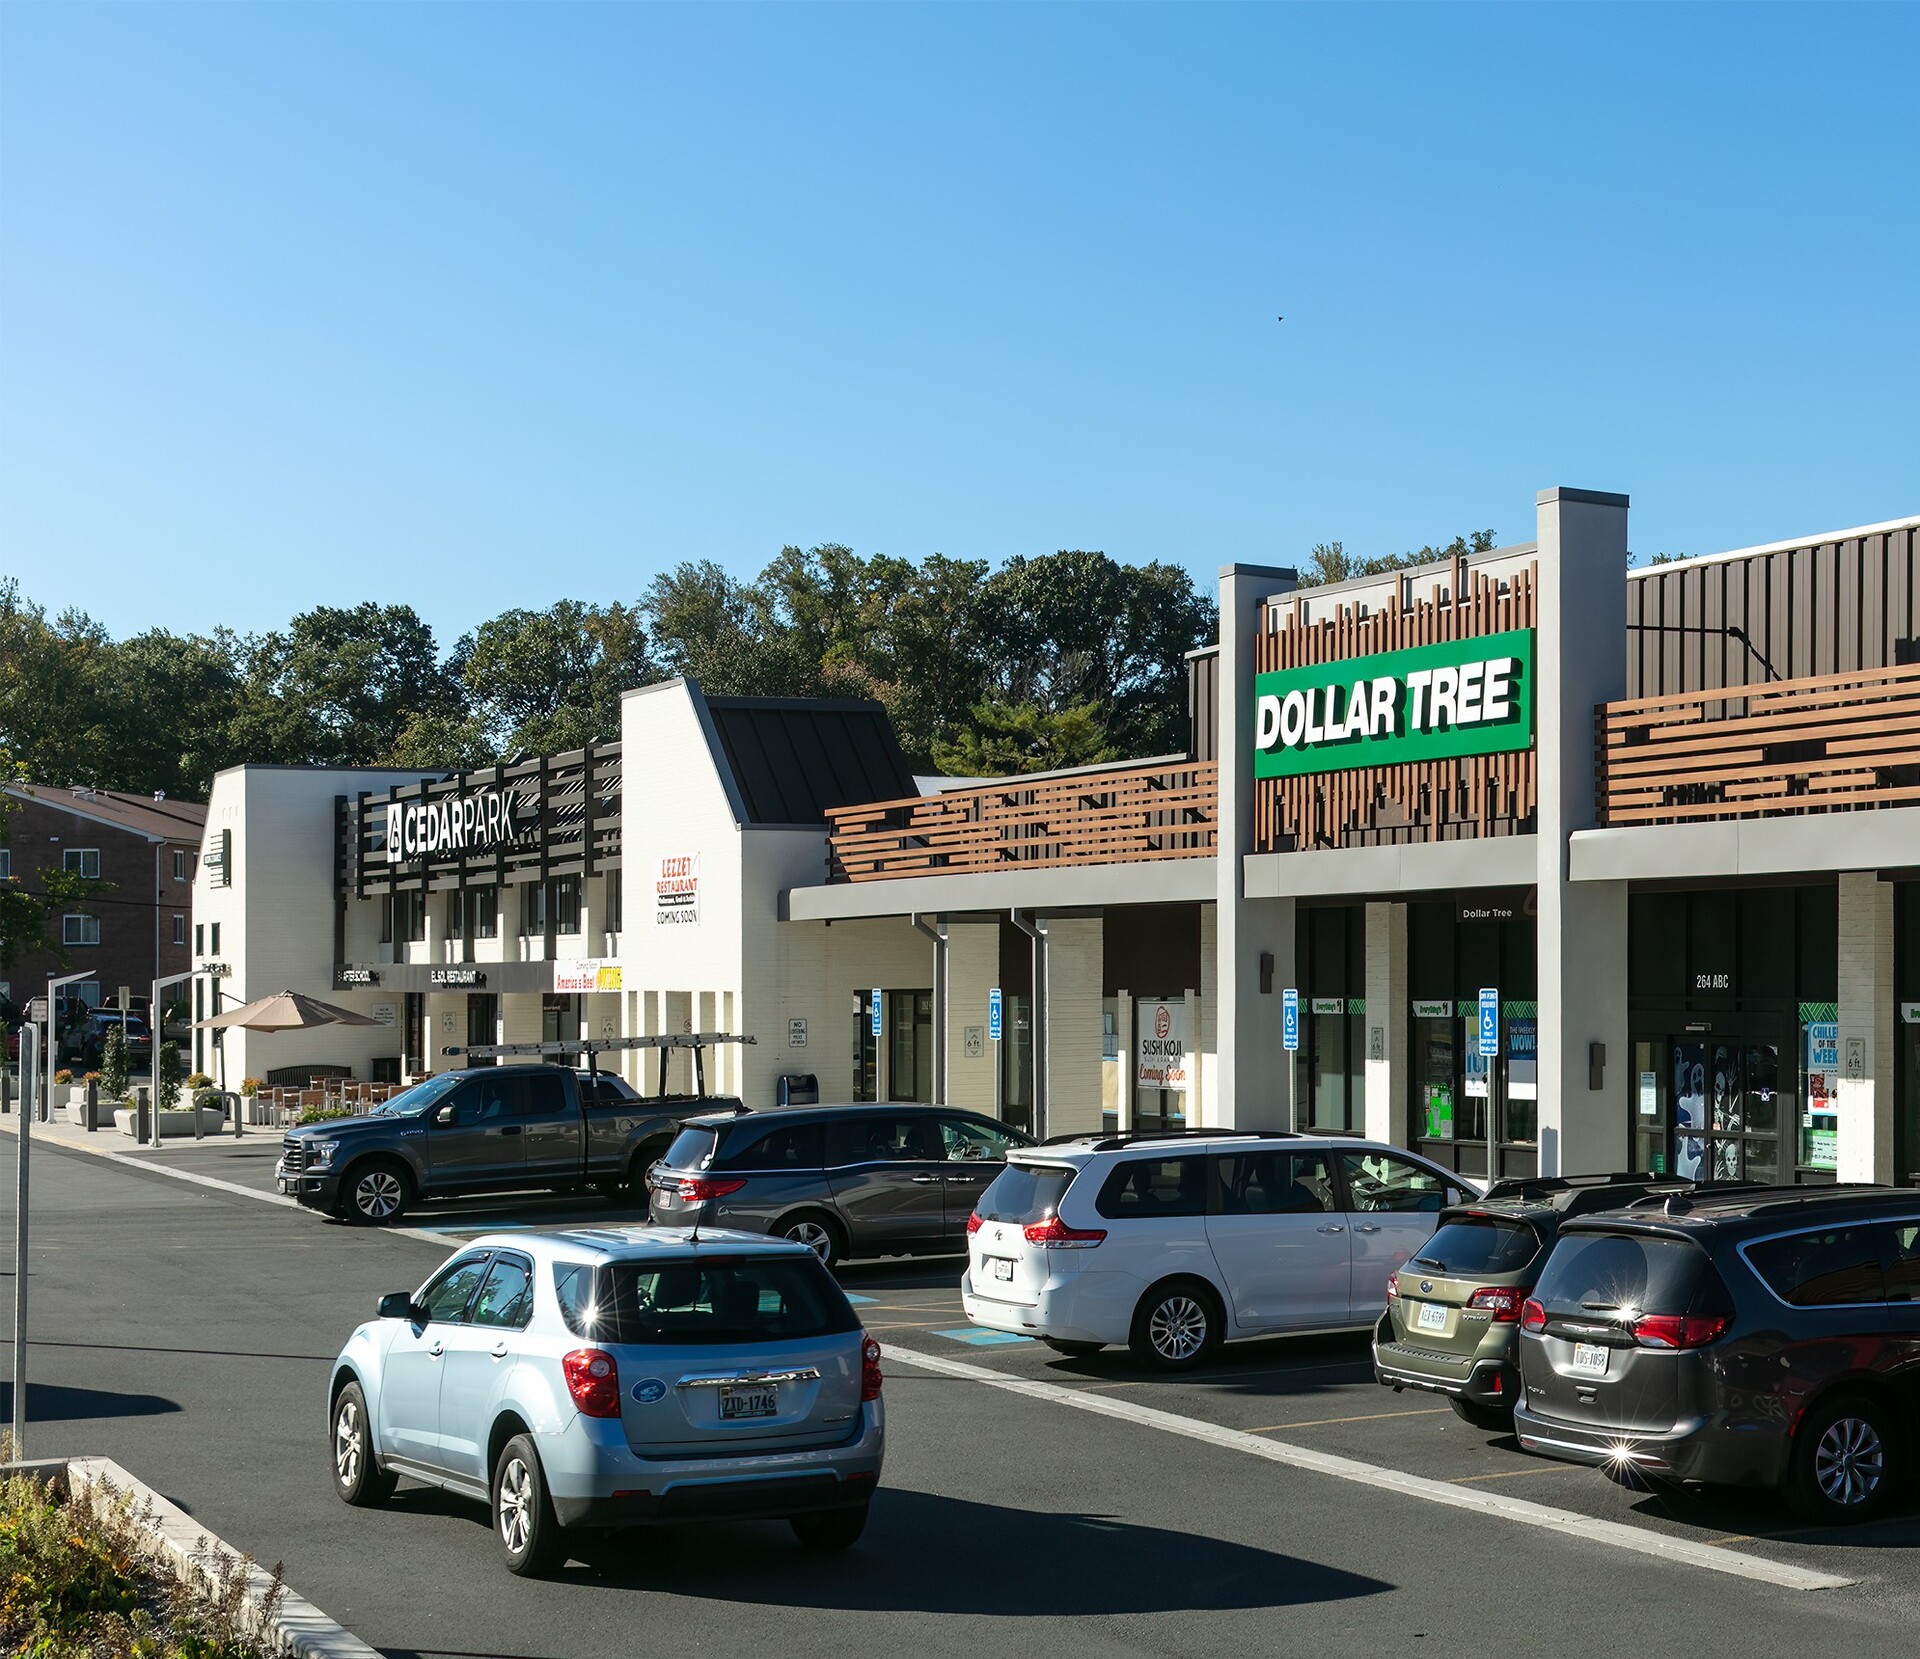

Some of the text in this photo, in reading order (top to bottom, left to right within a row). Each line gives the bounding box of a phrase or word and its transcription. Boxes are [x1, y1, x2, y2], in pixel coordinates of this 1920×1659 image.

[1256, 657, 1512, 750] DOLLAR TREE
[662, 857, 691, 878] LEZZET
[656, 878, 698, 894] RESTAURANT
[657, 909, 697, 925] COMING SOON
[1463, 908, 1512, 918] Dollar Tree
[1696, 974, 1728, 988] 264 ABC
[1142, 1039, 1182, 1056] SUSHI KOJI
[1510, 1034, 1536, 1051] WOW!
[1818, 1040, 1836, 1049] OF THE
[1848, 1059, 1853, 1068] 6
[1140, 1063, 1186, 1086] Coming Soon
[723, 1394, 775, 1411] ZXD-1746
